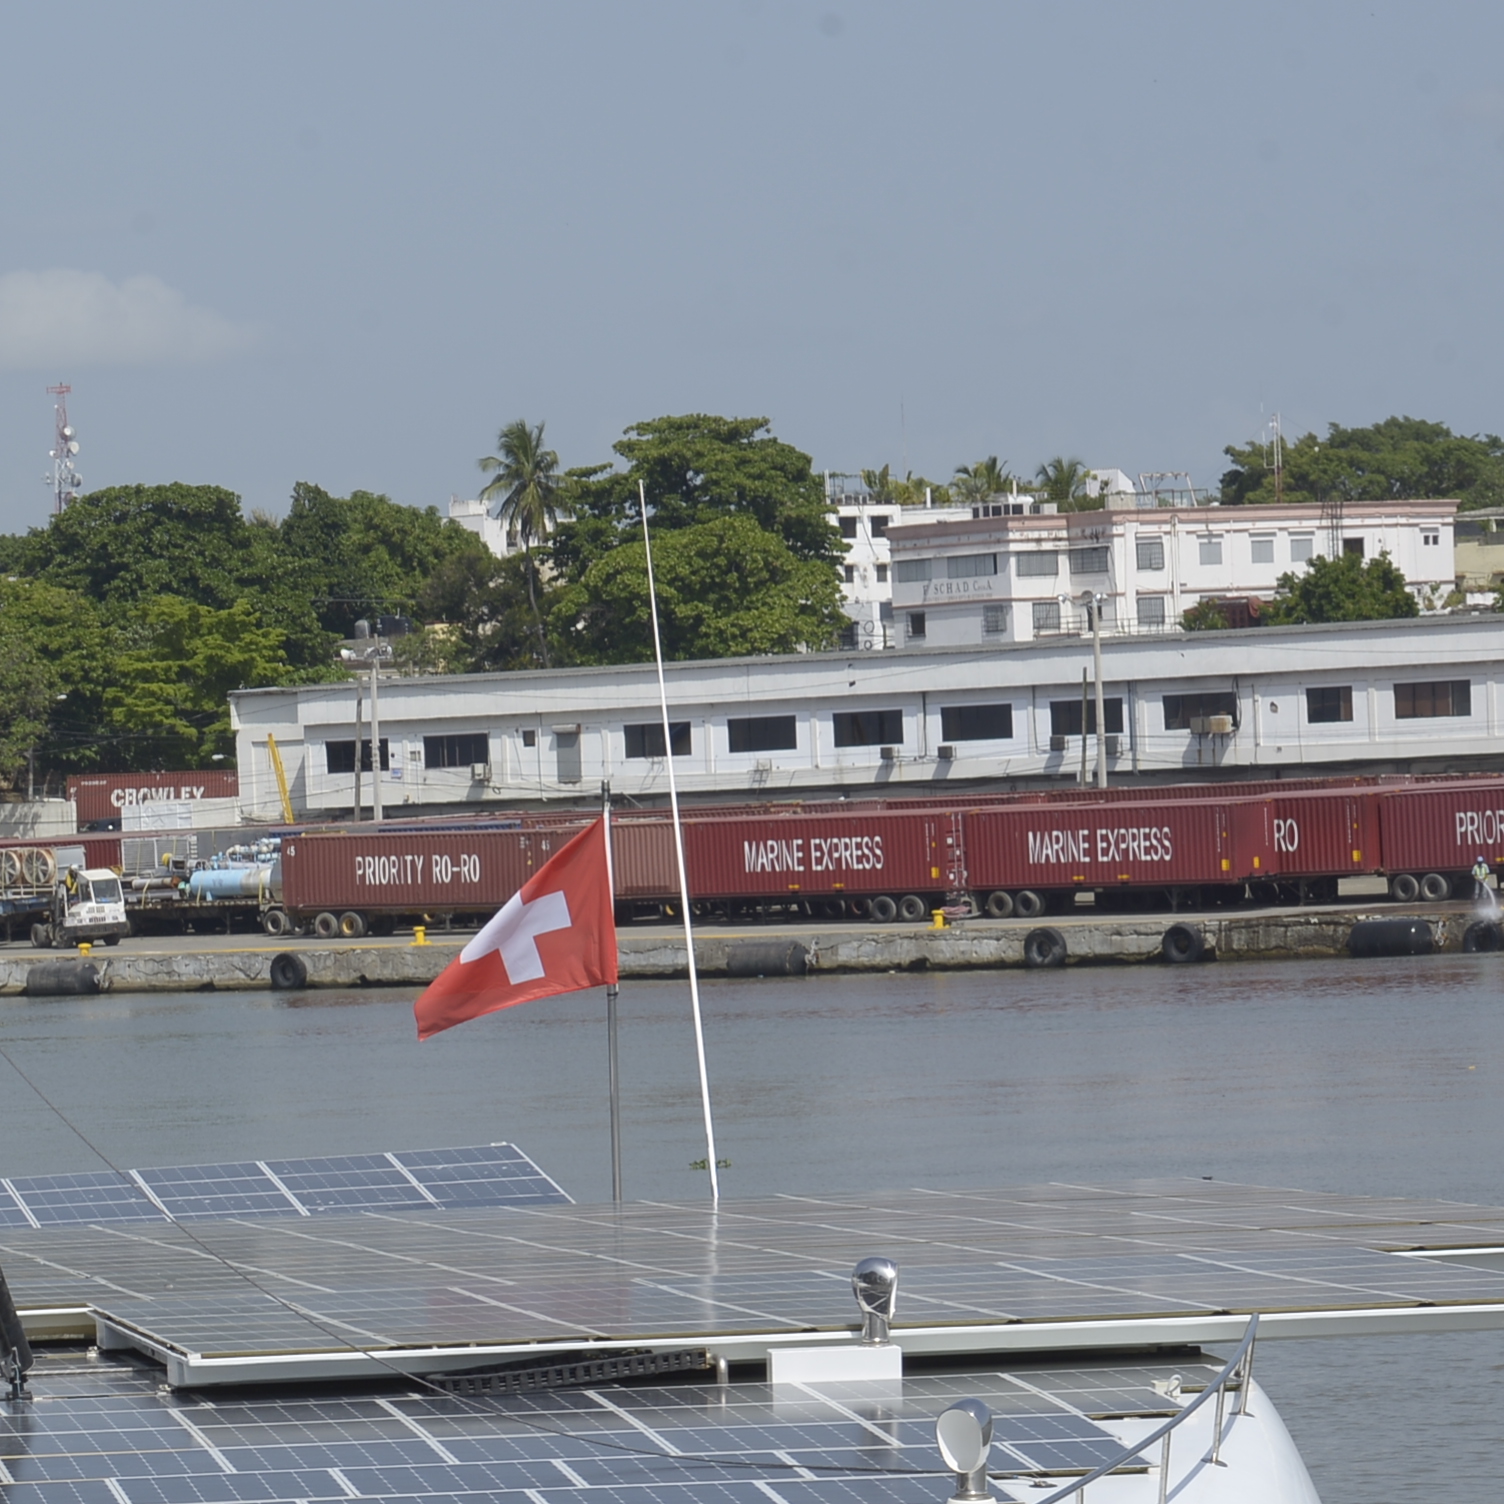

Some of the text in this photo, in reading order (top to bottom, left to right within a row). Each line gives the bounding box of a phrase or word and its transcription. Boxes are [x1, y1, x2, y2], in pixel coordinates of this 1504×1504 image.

[934, 581, 969, 595] SCHAD
[1028, 827, 1173, 864] MARINE EXPRESS
[1274, 818, 1298, 852] RO
[355, 854, 480, 885] PRIORITY RO-RO
[743, 838, 804, 873] MARINE
[810, 835, 884, 871] EXPRESS
